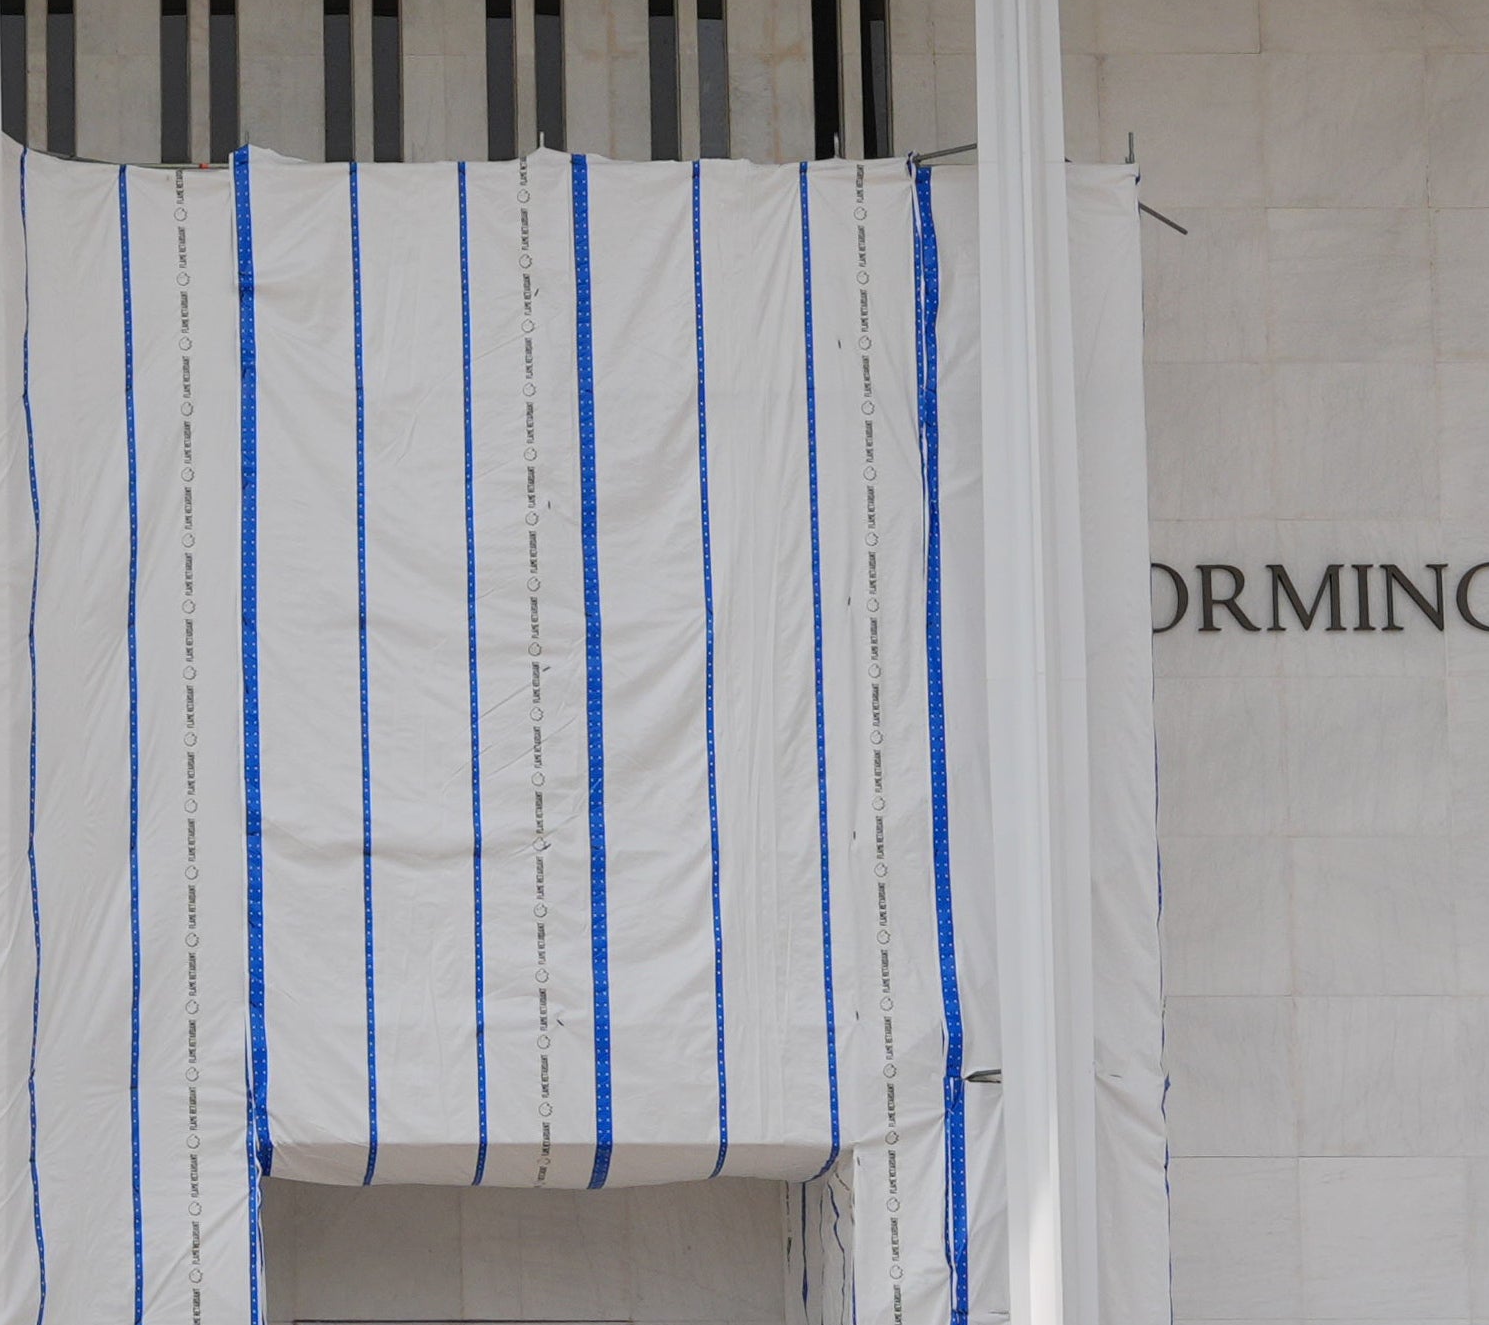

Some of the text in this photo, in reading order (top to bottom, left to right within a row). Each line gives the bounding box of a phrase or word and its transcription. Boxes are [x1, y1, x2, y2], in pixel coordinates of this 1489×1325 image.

[856, 190, 864, 203] FLAME
[521, 236, 529, 251] FLAME
[178, 254, 187, 268] FLAME
[858, 253, 866, 267] FLAME
[523, 302, 531, 316] FLAME
[181, 319, 189, 334] FLAME
[182, 384, 191, 398] FLAME
[863, 383, 872, 397] FLAME
[526, 429, 534, 444] FLAME
[865, 448, 874, 463] FLAME
[527, 495, 535, 509] FLAME
[184, 515, 192, 530] FLAME
[184, 581, 193, 596] FLAME
[868, 580, 876, 595] FLAME
[531, 624, 539, 639] FLAME
[185, 647, 193, 662] FLAME
[870, 646, 878, 660] FLAME
[532, 689, 540, 703] FLAME
[186, 714, 194, 729] FLAME
[872, 712, 880, 727] FLAME
[535, 820, 543, 834] FLAME
[187, 847, 195, 862] FLAME
[876, 844, 884, 859] FLAME
[536, 885, 544, 900] FLAME
[188, 914, 196, 929] FLAME
[879, 911, 887, 926] FLAME
[188, 982, 196, 997] FLAME
[539, 1016, 547, 1031] FLAME
[188, 1049, 196, 1064] FLAME
[885, 1045, 893, 1060] FLAME
[541, 1084, 549, 1099] FLAME
[190, 1183, 198, 1198] FLAME
[889, 1179, 897, 1194] FLAME
[191, 1250, 199, 1265] FLAME
